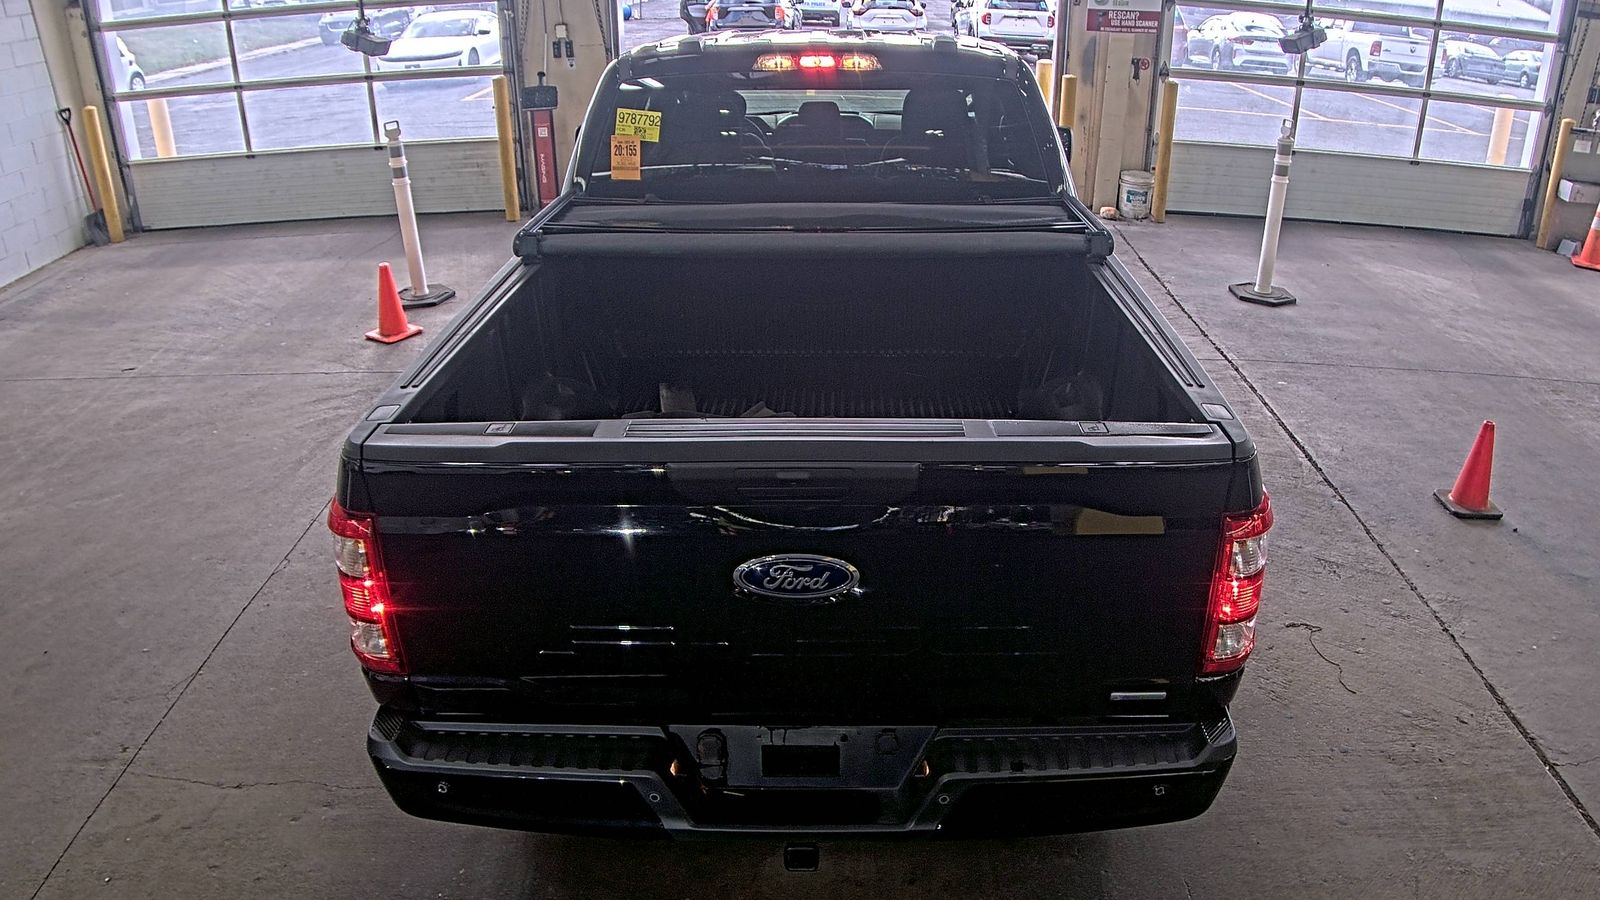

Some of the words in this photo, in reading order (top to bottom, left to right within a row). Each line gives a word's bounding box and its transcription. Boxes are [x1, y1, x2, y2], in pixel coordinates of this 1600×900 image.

[1108, 10, 1140, 20] RESCAN?
[618, 112, 660, 126] 9787792
[614, 144, 637, 156] 20:155
[763, 564, 831, 590] Ford
